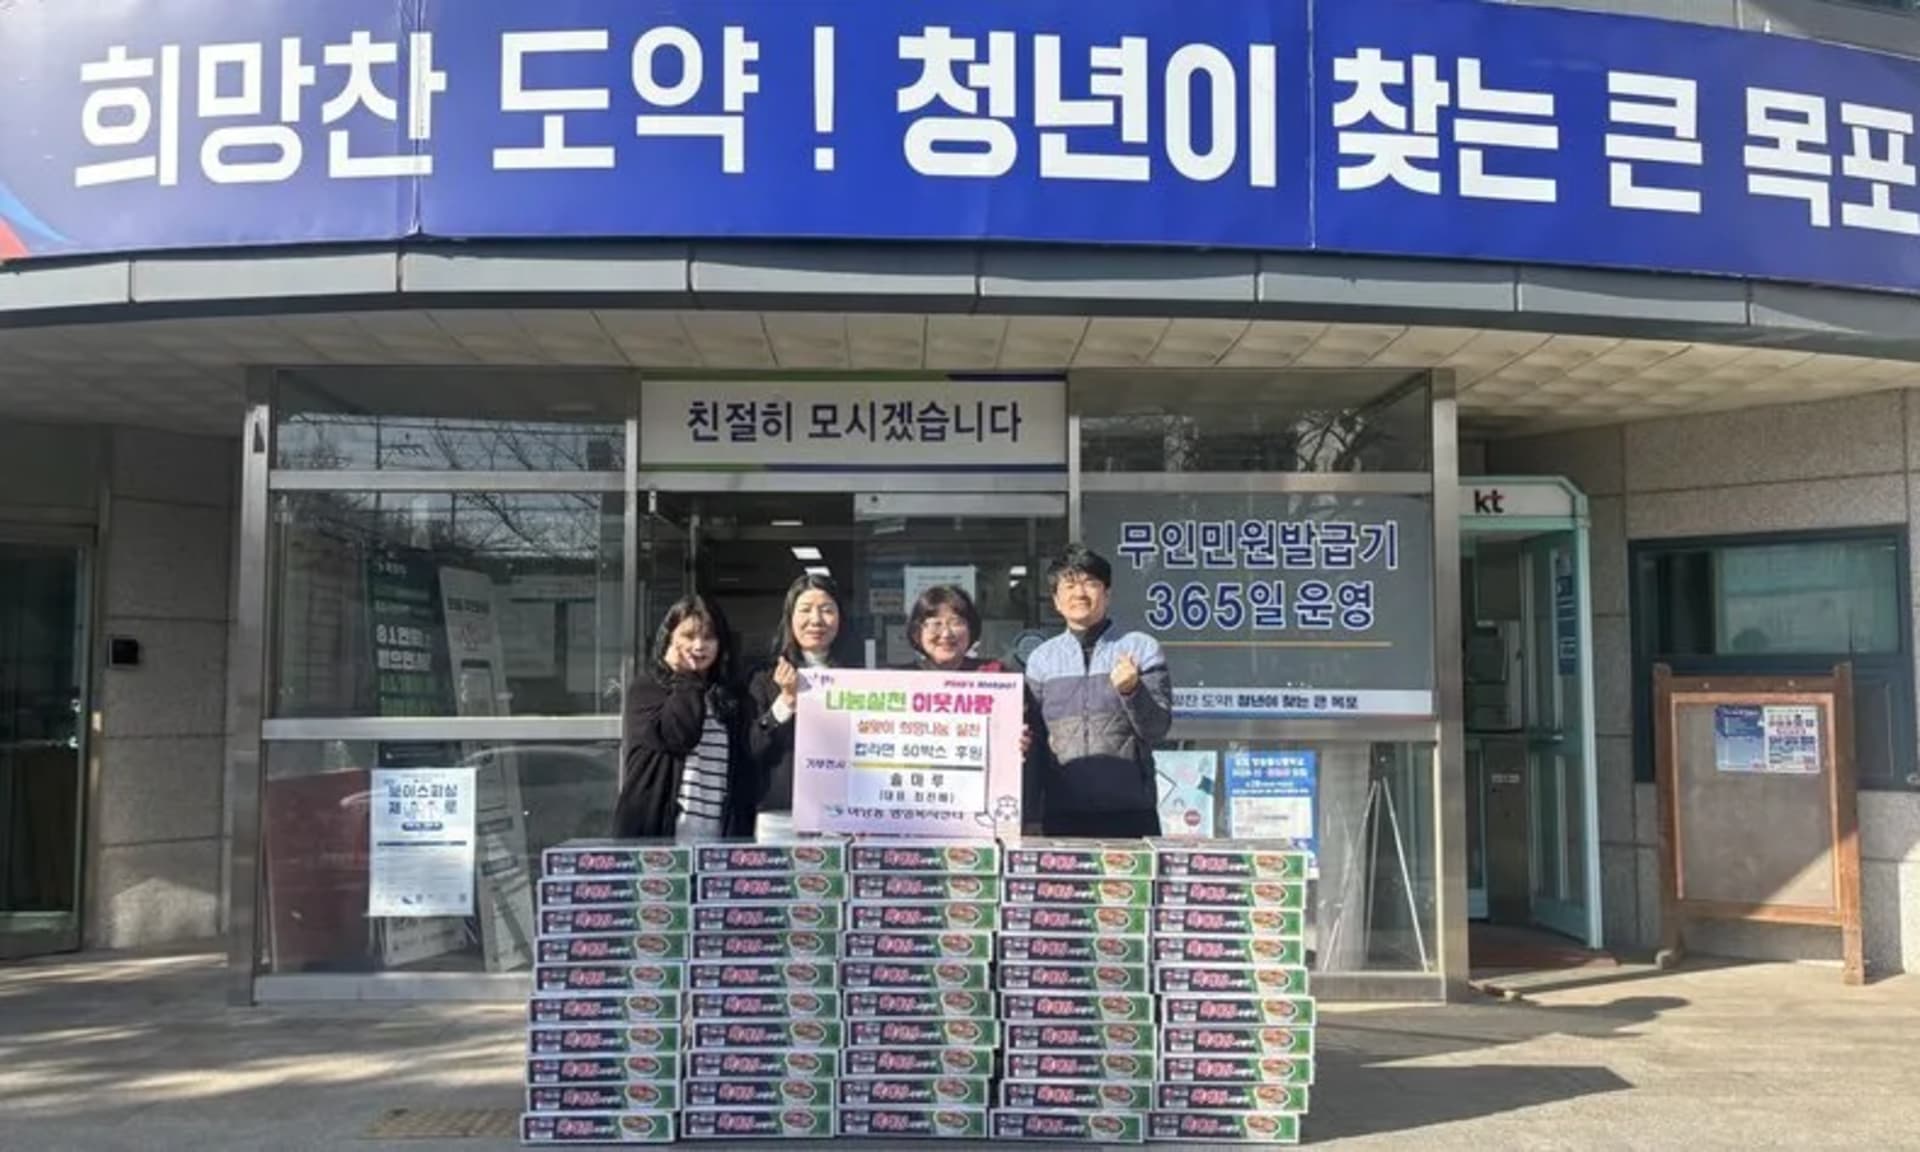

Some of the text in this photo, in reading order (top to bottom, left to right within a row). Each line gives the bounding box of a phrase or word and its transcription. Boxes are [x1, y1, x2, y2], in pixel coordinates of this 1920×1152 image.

[74, 26, 1920, 234] 희망찬 도약 ! 청년이 찾는 큰 목포
[687, 401, 1022, 442] 친절히 모시겠습니다
[1474, 490, 1504, 514] kt
[1118, 520, 1399, 569] 무인민원발급기
[1146, 581, 1375, 630] 365일 운영
[826, 690, 994, 714] 나눔실천 이웃사랑
